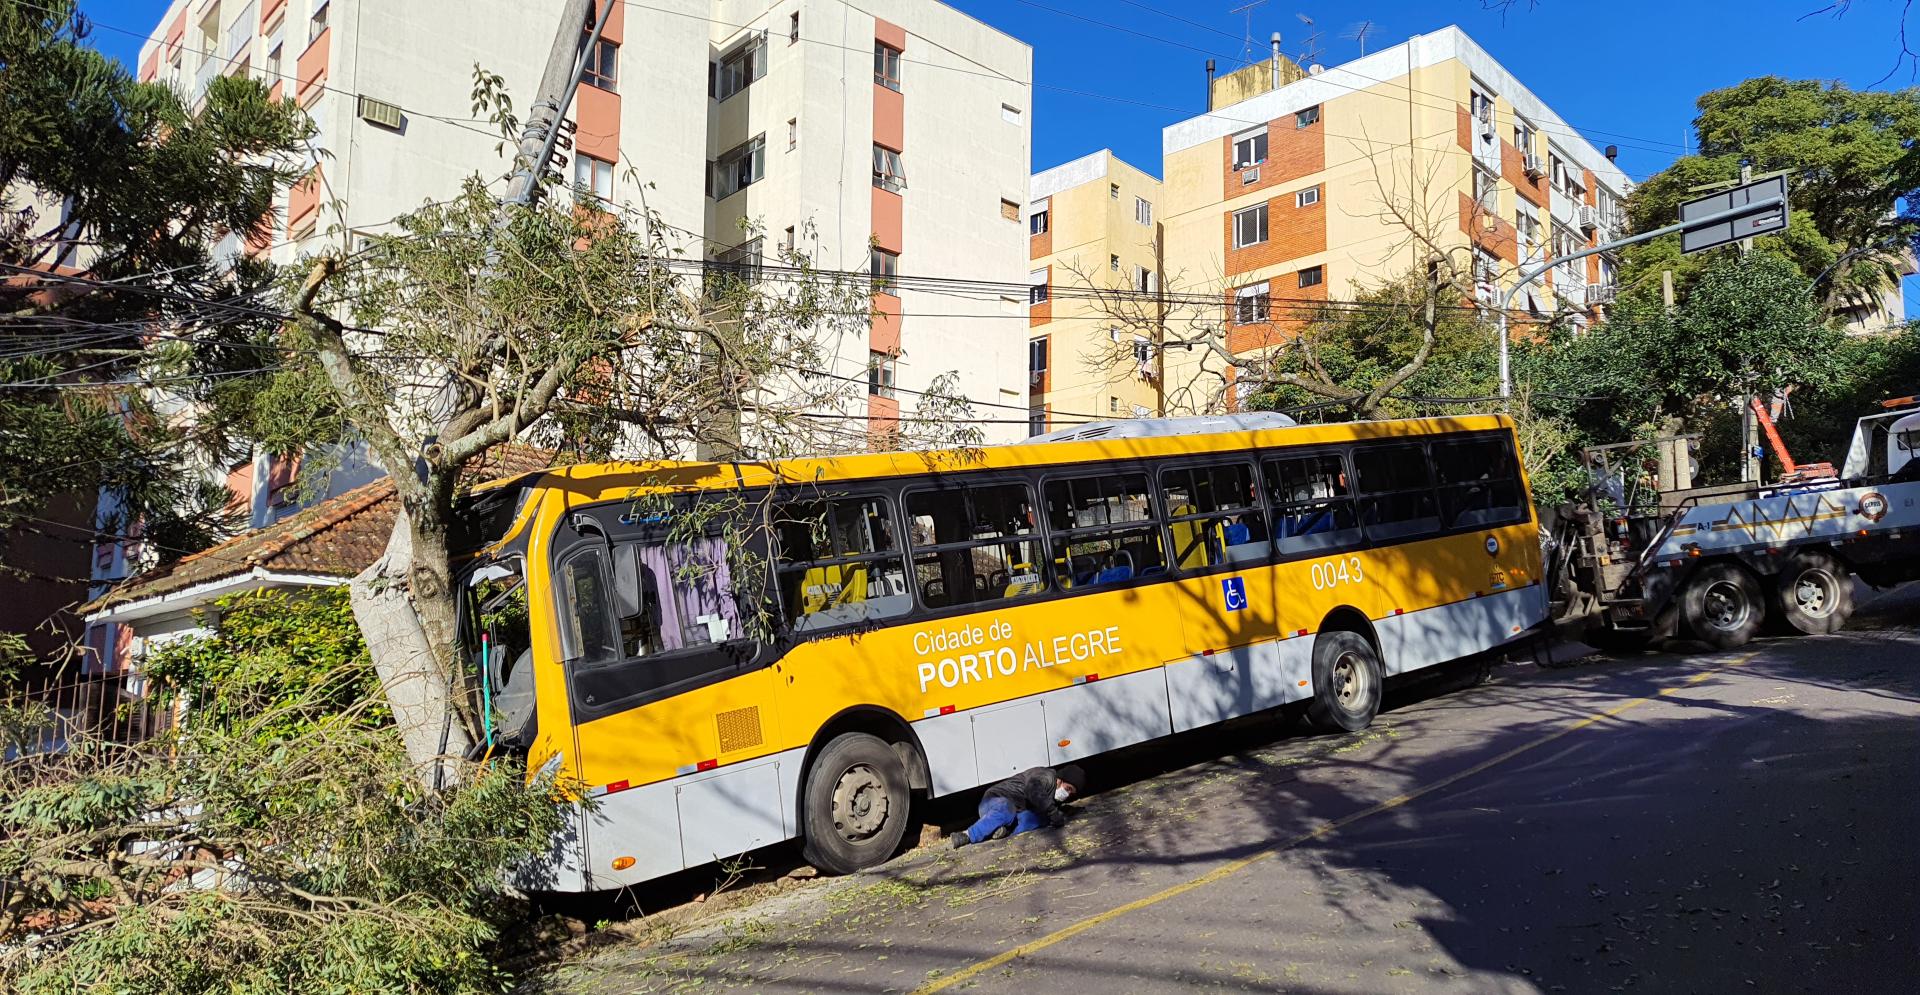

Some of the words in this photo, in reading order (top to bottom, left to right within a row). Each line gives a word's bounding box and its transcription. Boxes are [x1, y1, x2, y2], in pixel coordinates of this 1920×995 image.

[1311, 556, 1364, 591] 0043
[913, 623, 984, 656] Cidade
[988, 618, 1013, 641] de
[917, 647, 1017, 693] PORTO
[1023, 626, 1122, 672] ALEGRE
